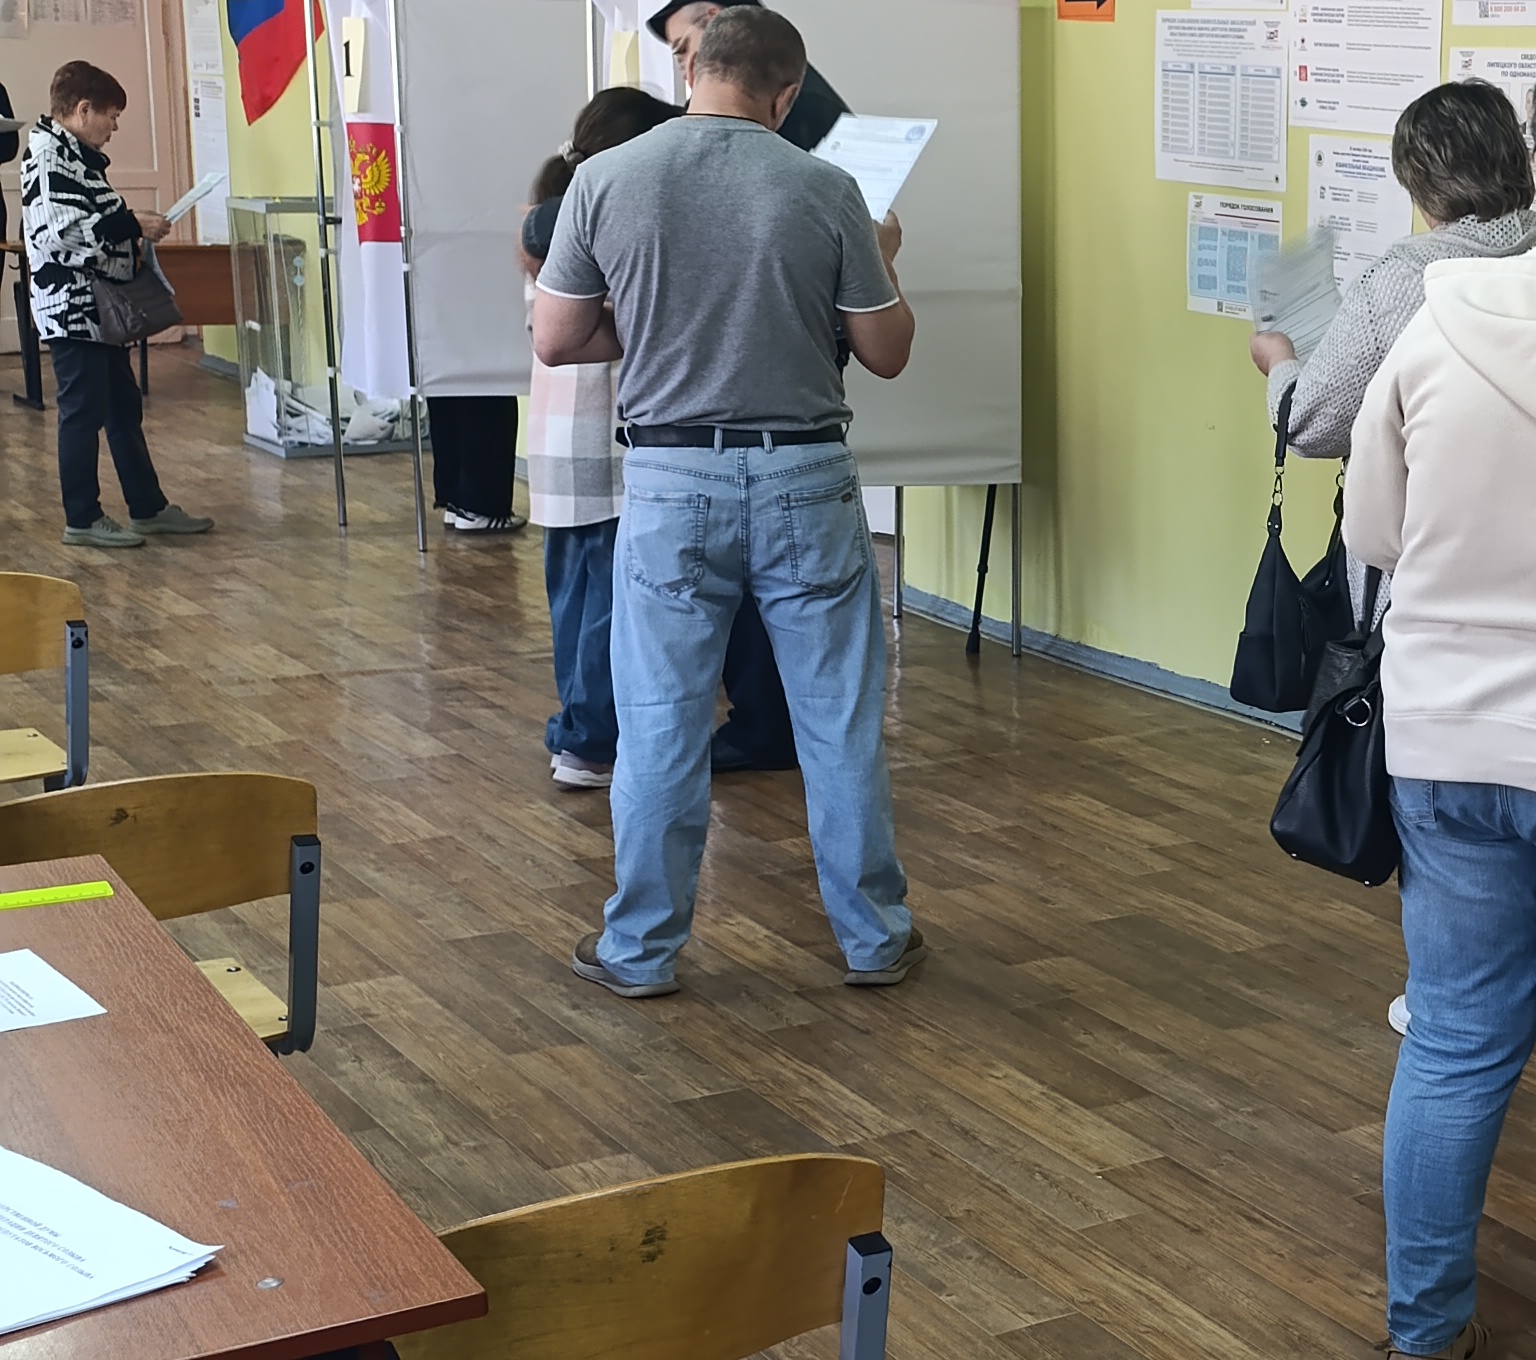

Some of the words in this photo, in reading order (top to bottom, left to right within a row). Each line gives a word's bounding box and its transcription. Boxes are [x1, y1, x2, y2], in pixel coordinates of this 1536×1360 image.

[343, 39, 355, 77] 1
[1487, 61, 1517, 69] ЛИПЕЦКОГО
[1220, 202, 1240, 210] ПОРЯДОК
[1240, 204, 1274, 213] ГОЛОСОВАНИЯ
